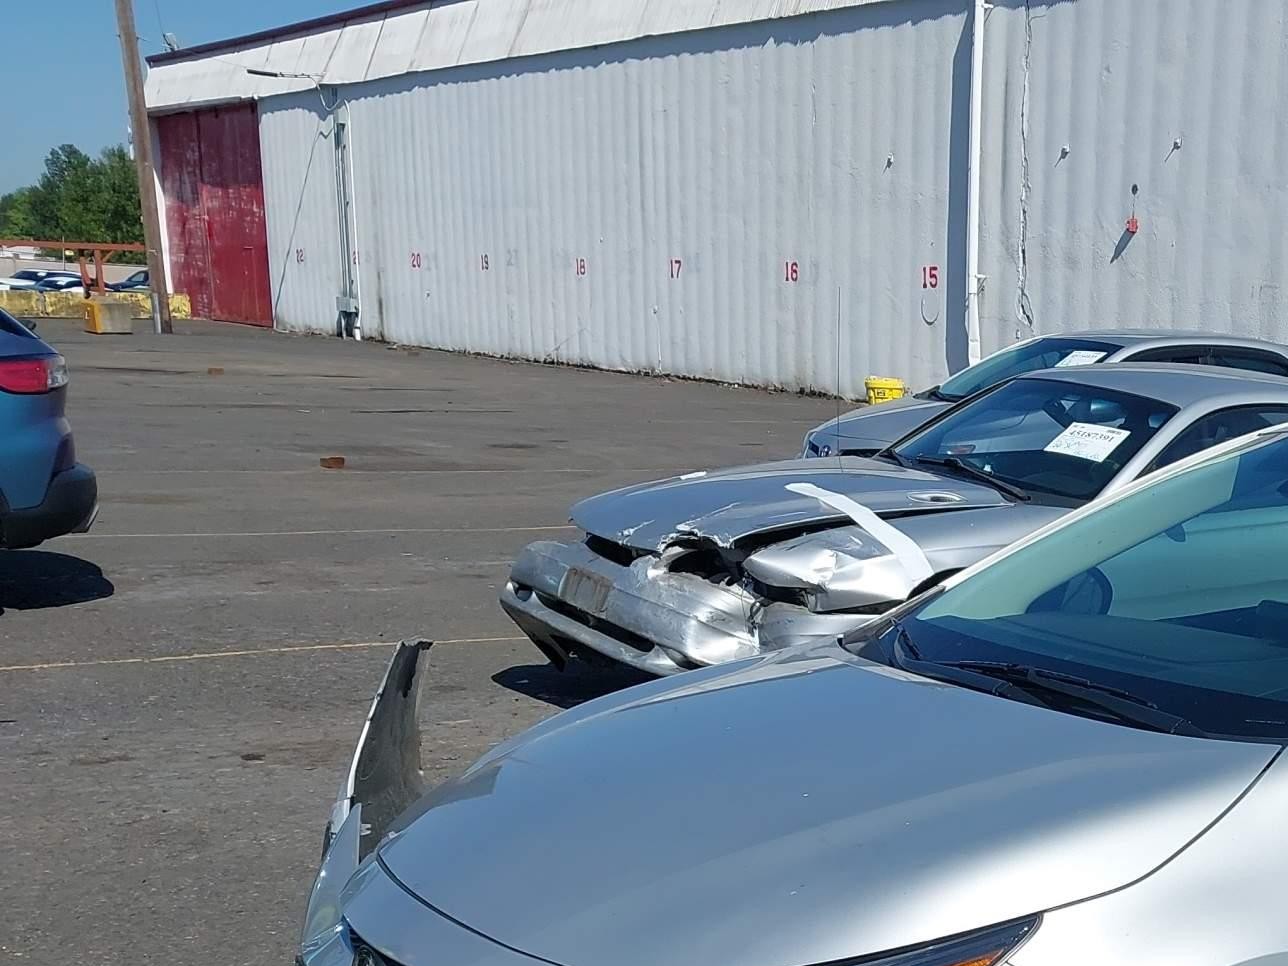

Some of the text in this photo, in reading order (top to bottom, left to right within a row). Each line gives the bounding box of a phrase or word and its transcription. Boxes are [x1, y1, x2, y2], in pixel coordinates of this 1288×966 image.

[411, 252, 421, 268] 20
[481, 254, 489, 270] 19
[576, 258, 586, 276] 18
[670, 259, 682, 279] 17
[785, 261, 798, 282] 16
[922, 266, 938, 288] 15
